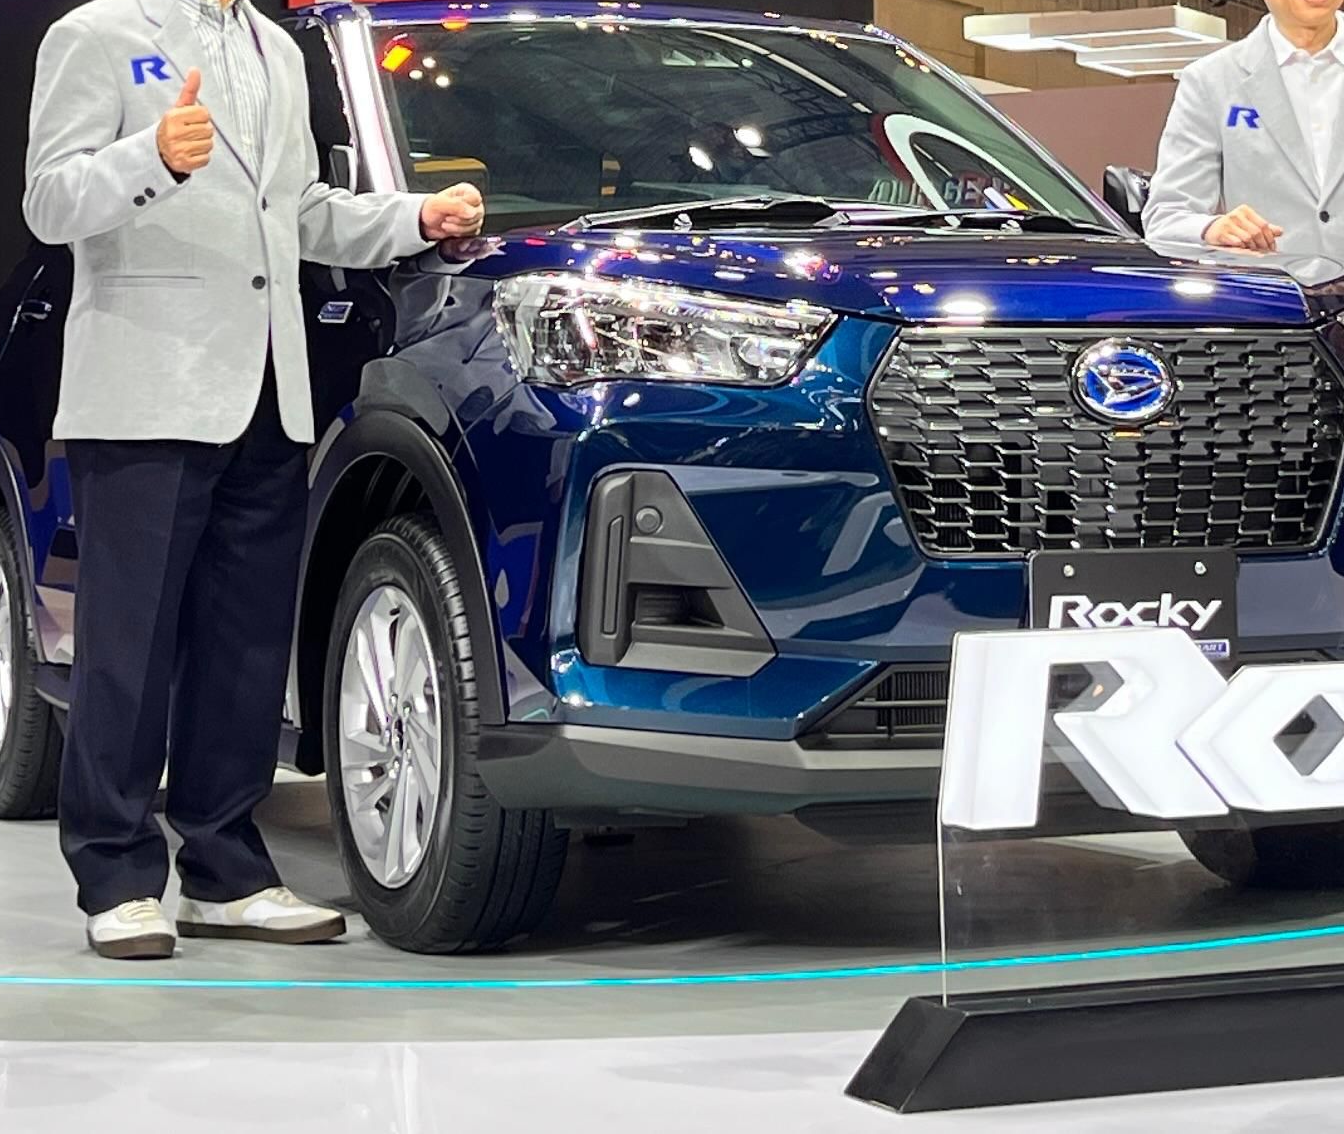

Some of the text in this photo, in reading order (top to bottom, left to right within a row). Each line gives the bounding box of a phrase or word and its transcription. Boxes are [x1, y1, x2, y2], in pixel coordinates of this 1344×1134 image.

[131, 54, 173, 86] R
[1226, 105, 1261, 130] R
[1048, 592, 1223, 632] Rocky
